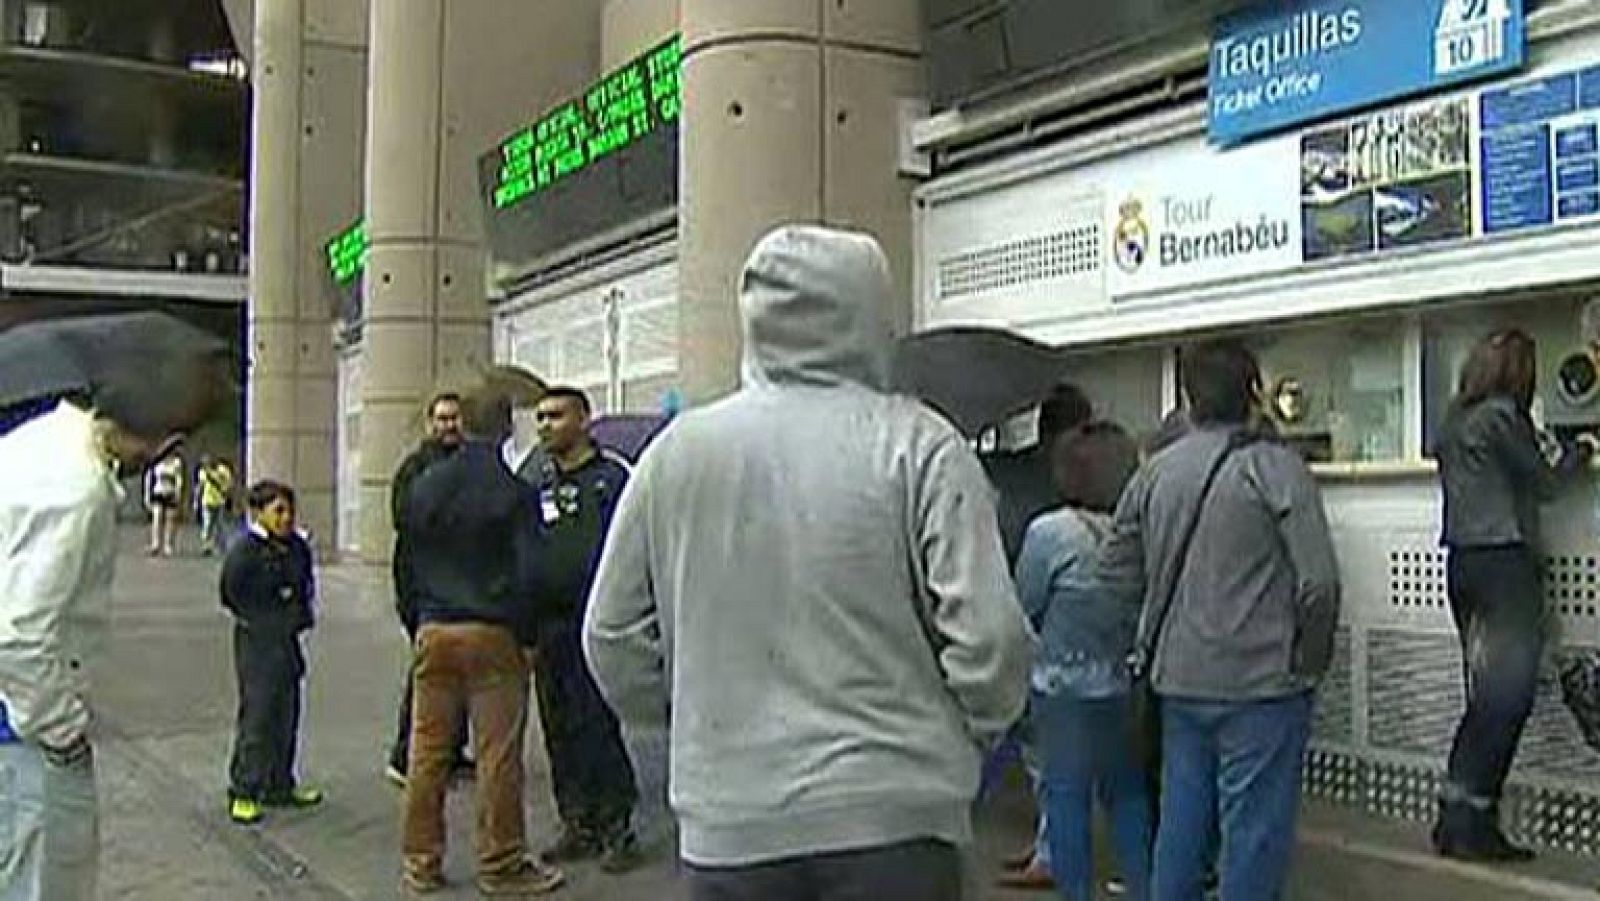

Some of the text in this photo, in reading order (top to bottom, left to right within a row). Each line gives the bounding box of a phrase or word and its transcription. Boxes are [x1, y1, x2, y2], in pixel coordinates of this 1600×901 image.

[1213, 7, 1362, 78] Taquillas
[1448, 35, 1474, 66] 10
[1264, 71, 1321, 105] Office
[1160, 193, 1215, 227] Tour
[1159, 213, 1289, 268] Bernabéu
